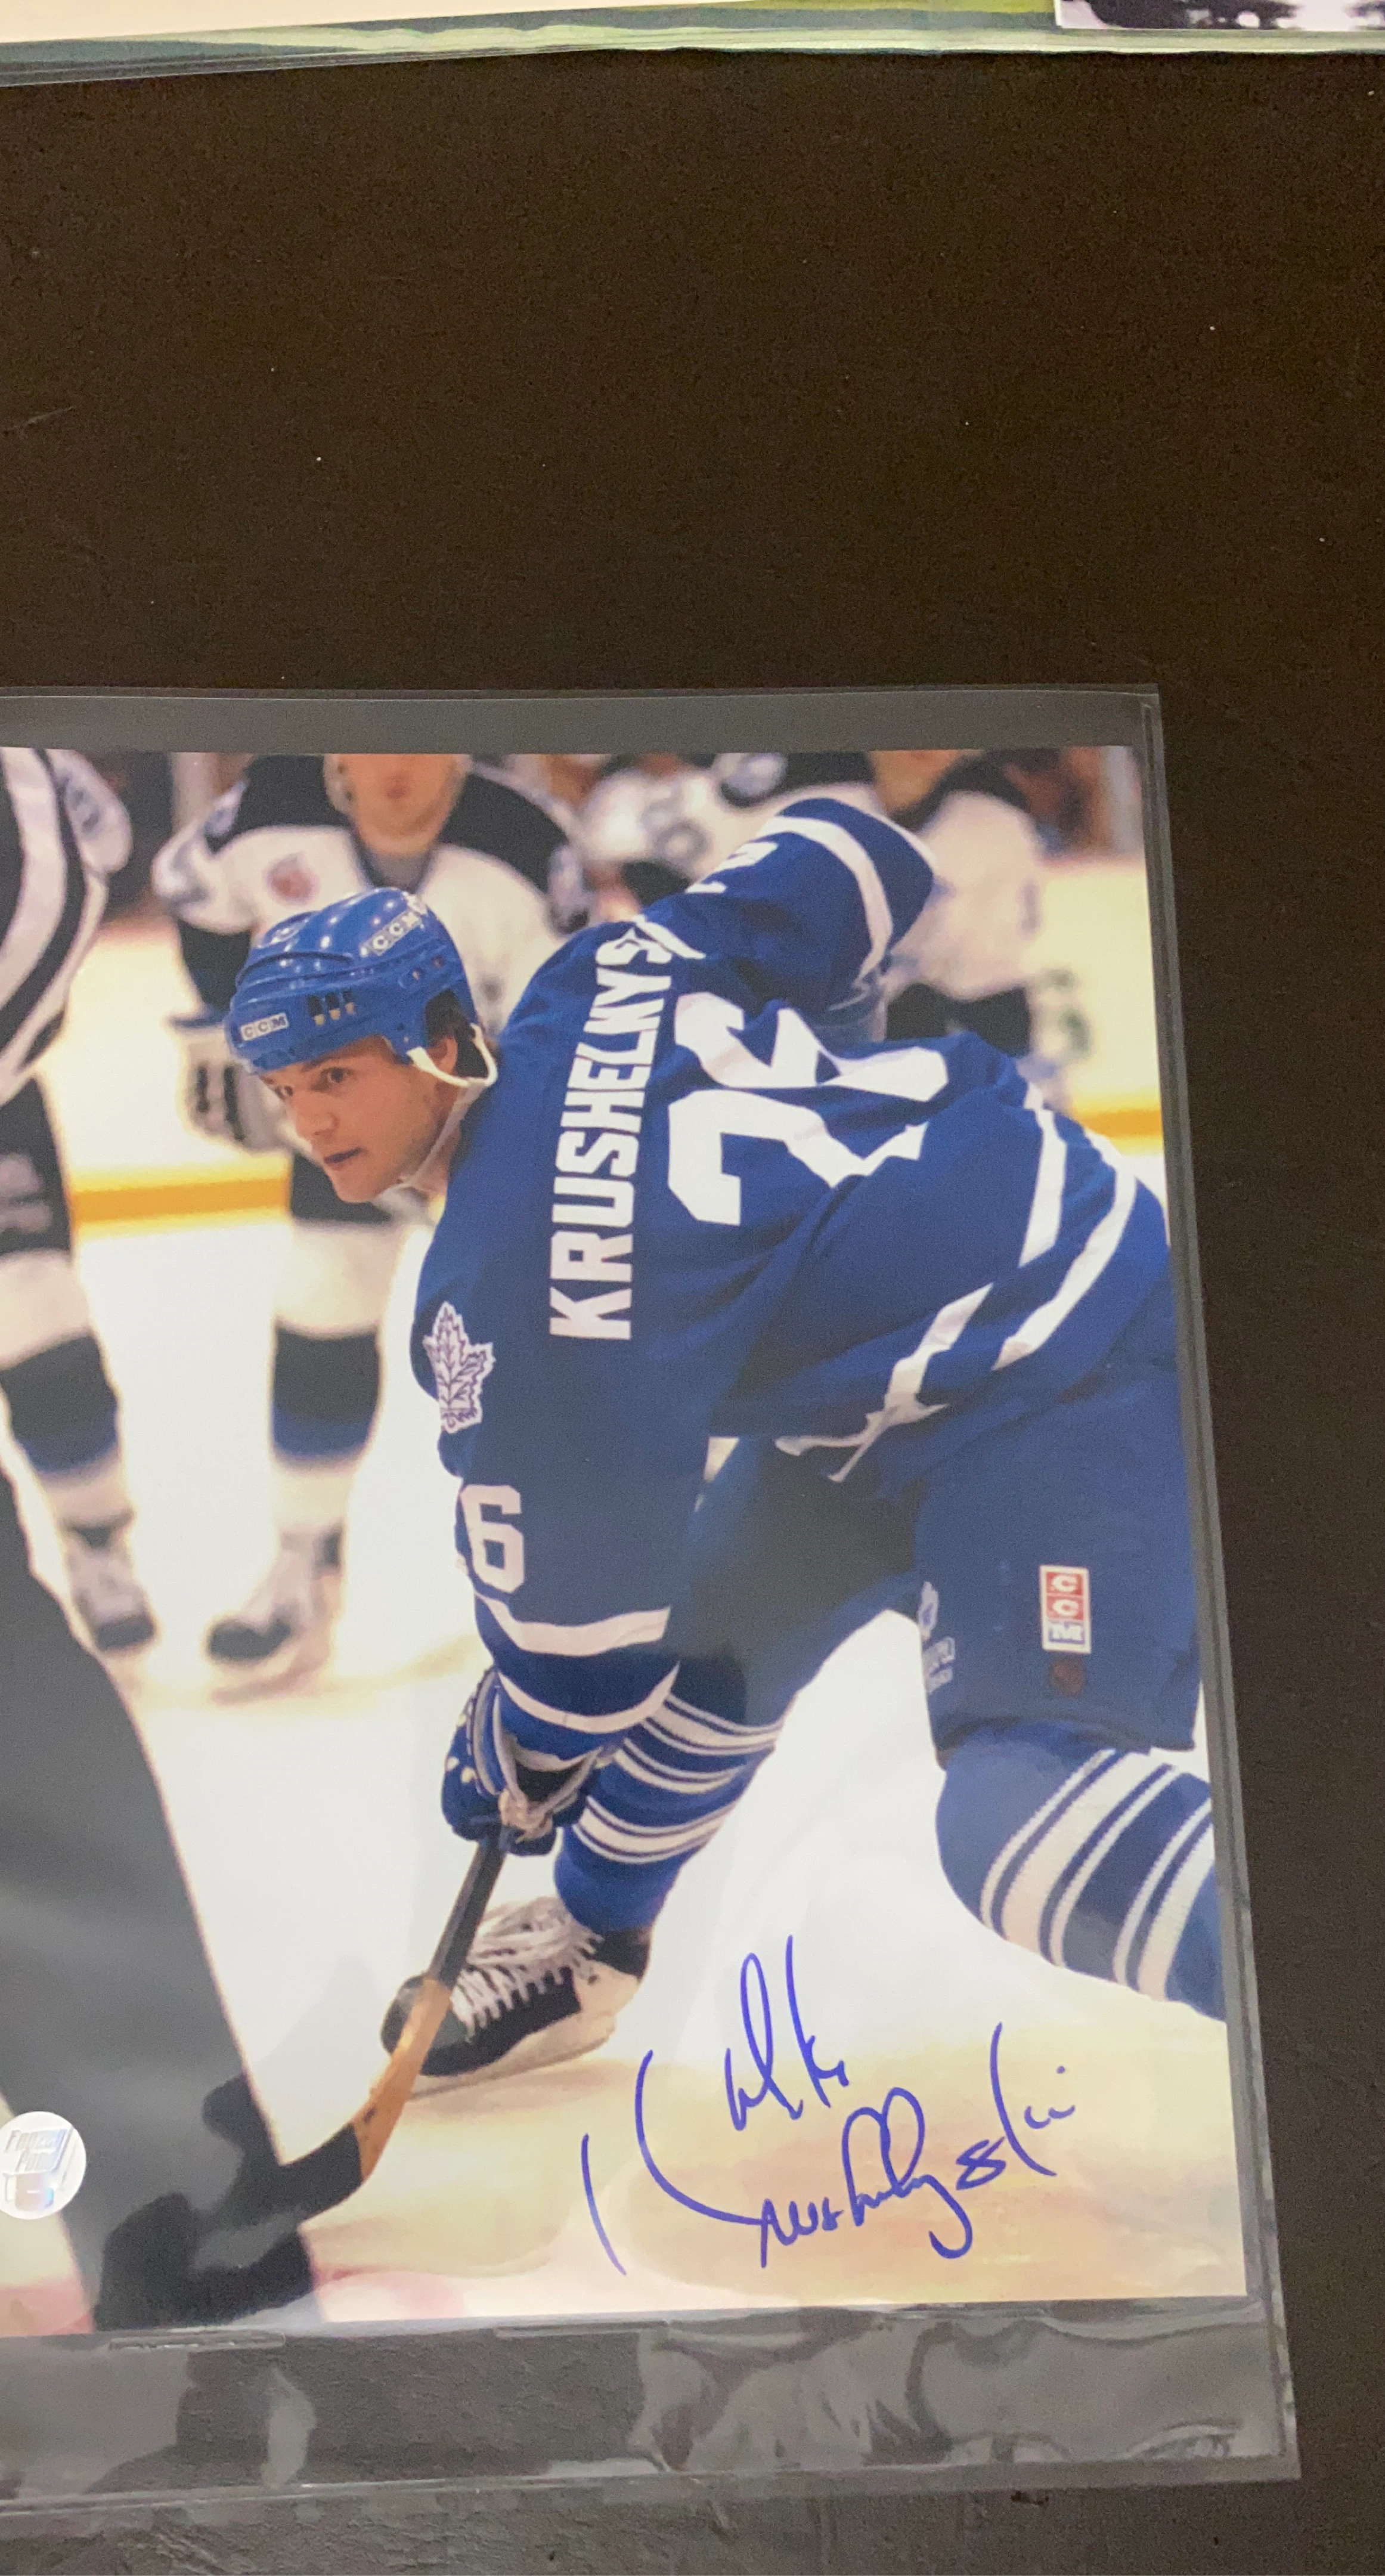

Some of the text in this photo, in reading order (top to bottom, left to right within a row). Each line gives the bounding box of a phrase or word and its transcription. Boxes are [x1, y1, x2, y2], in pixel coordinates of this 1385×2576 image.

[370, 910, 421, 954] CCM
[241, 1014, 289, 1040] CCM
[668, 992, 949, 1226] 26
[1046, 1571, 1087, 1646] CCM
